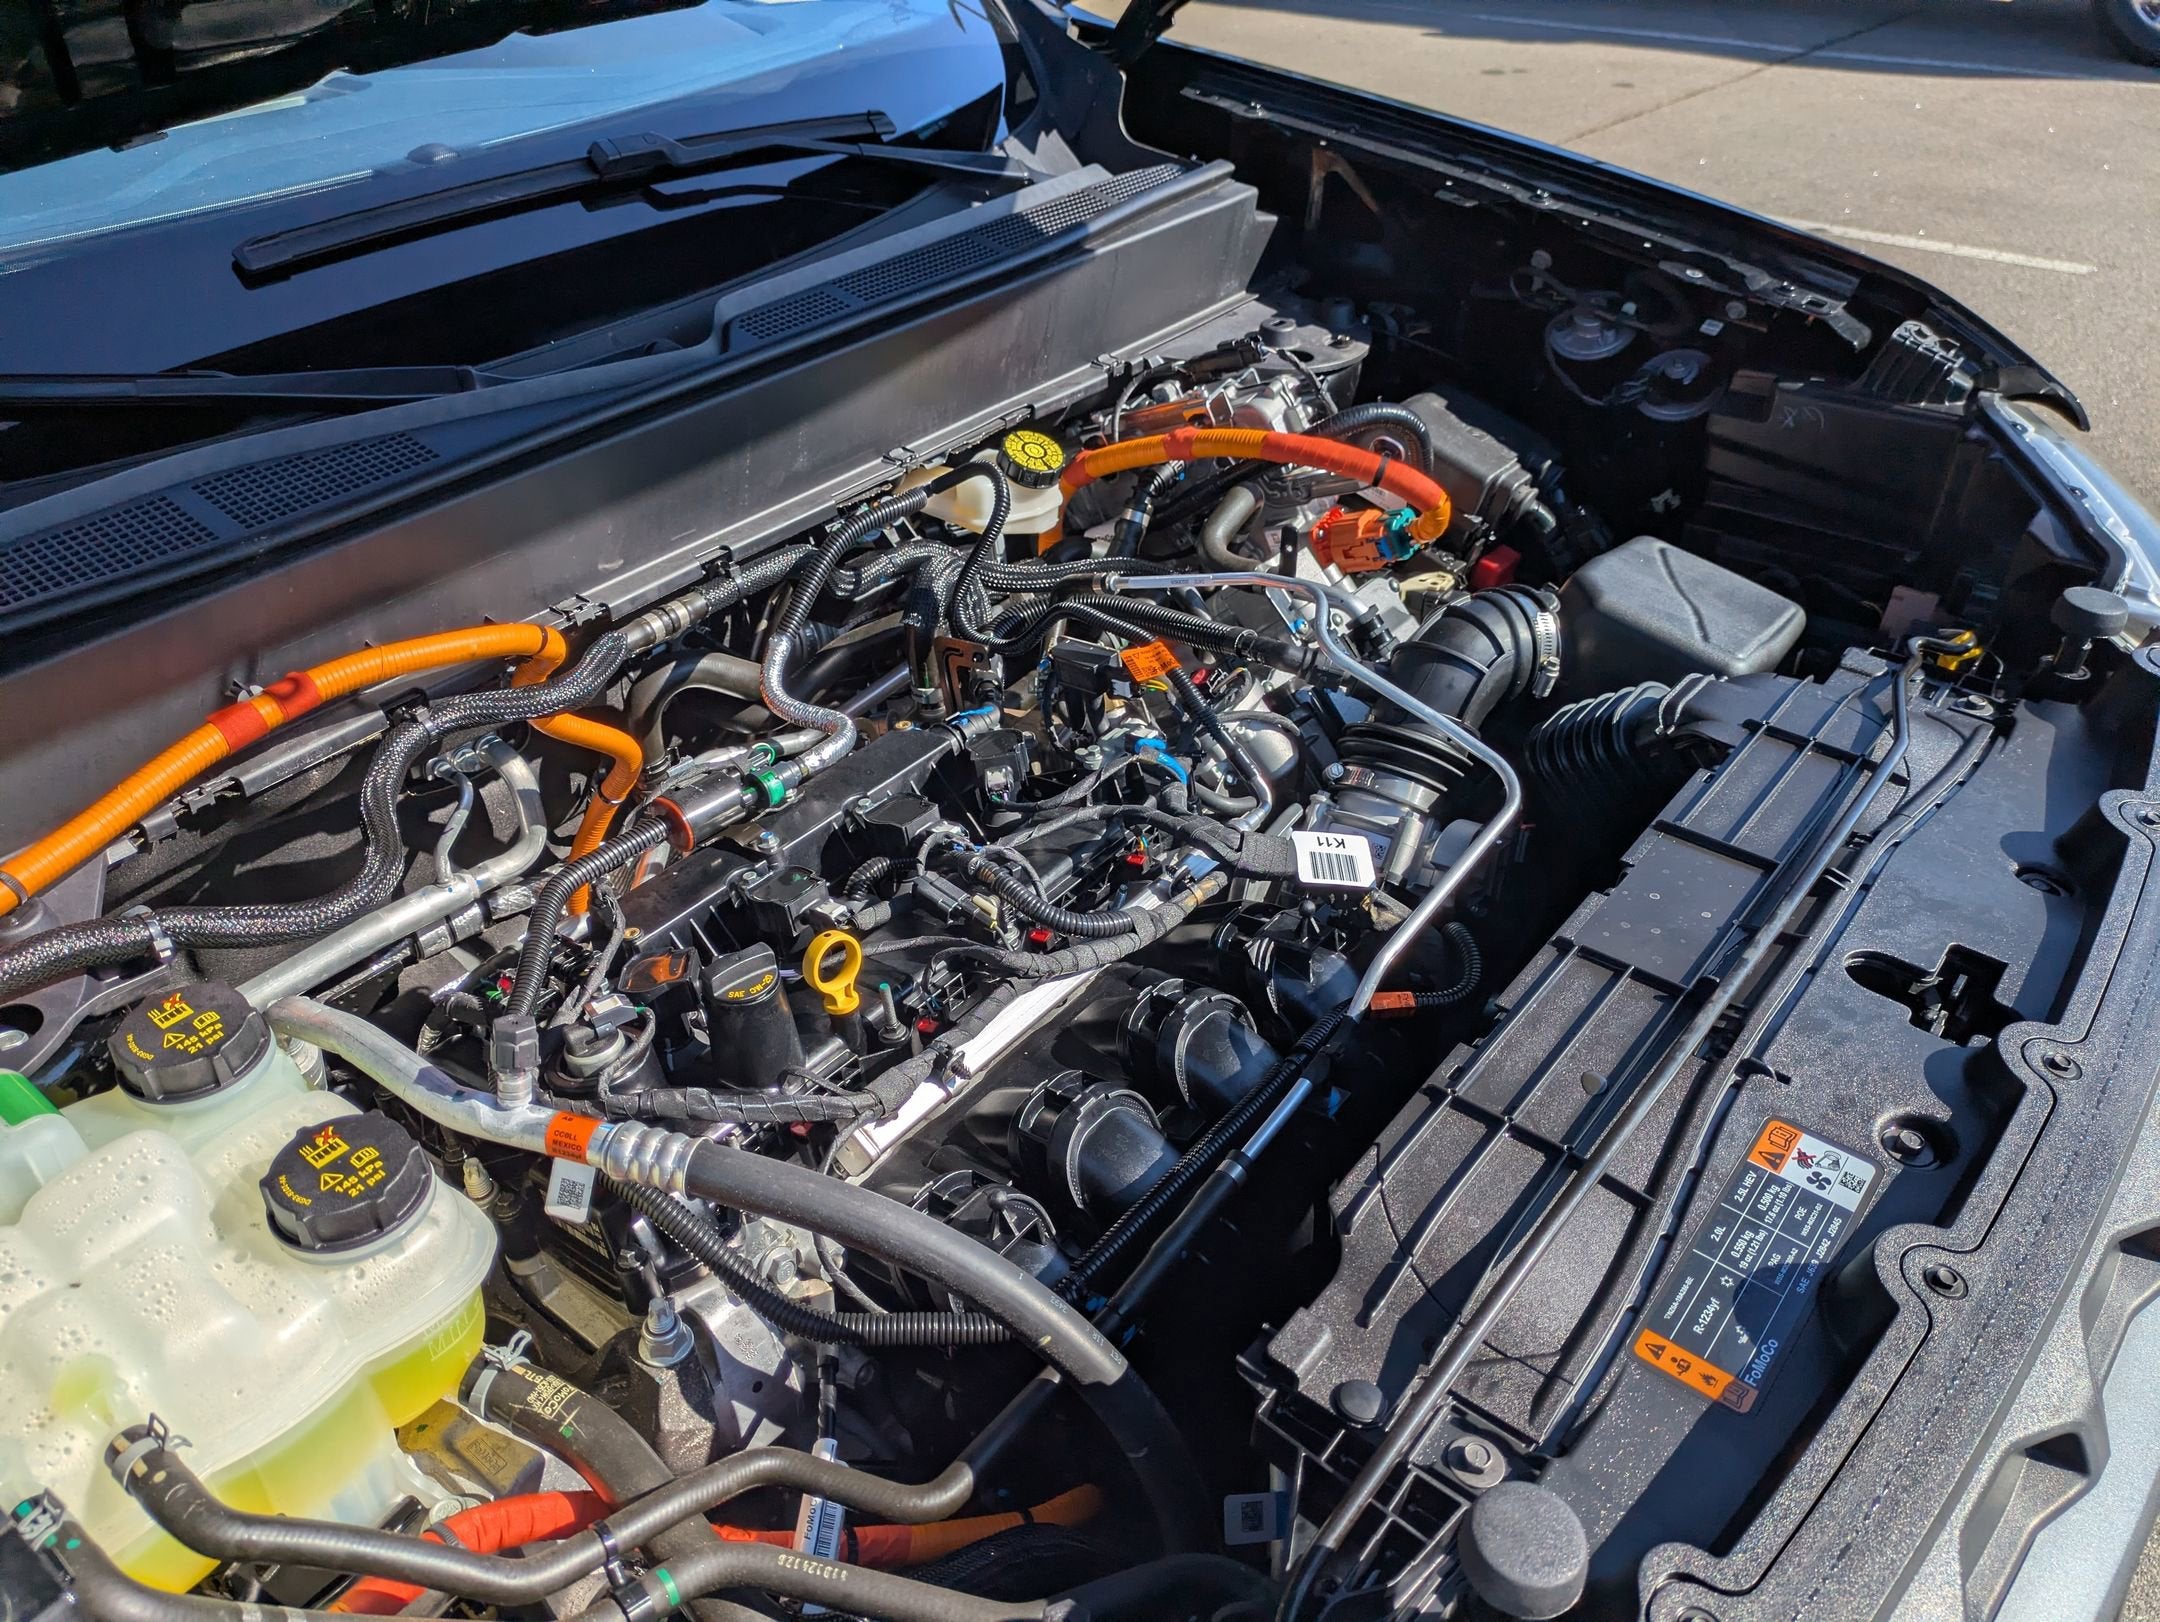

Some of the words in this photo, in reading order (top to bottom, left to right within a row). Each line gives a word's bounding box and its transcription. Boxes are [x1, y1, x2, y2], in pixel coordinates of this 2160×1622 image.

[1317, 836, 1346, 849] K11
[728, 990, 745, 998] SAE
[176, 1036, 198, 1050] 145
[198, 1023, 223, 1038] kPa
[187, 1042, 203, 1054] 21
[205, 1031, 224, 1046] psi
[552, 1139, 582, 1152] MEXICO
[335, 1176, 358, 1193] 145
[358, 1161, 384, 1178] kPa
[348, 1185, 365, 1198] 21
[366, 1170, 386, 1187] psi
[1734, 1187, 1749, 1203] 2.5L
[1742, 1170, 1757, 1188] HEV
[1767, 1184, 1780, 1198] kg
[1794, 1206, 1808, 1221] POE
[1711, 1226, 1726, 1242] 2.0L
[1731, 1237, 1747, 1258] 0.550
[1740, 1230, 1755, 1242] kg
[1739, 1260, 1749, 1270] 19
[1767, 1253, 1781, 1268] PAG
[1796, 1277, 1810, 1294] SAE
[1807, 1259, 1820, 1277] J639
[1693, 1296, 1720, 1335] R-1234yf
[1744, 1339, 1778, 1387] FoMoCo
[544, 1384, 577, 1415] FoMoCo
